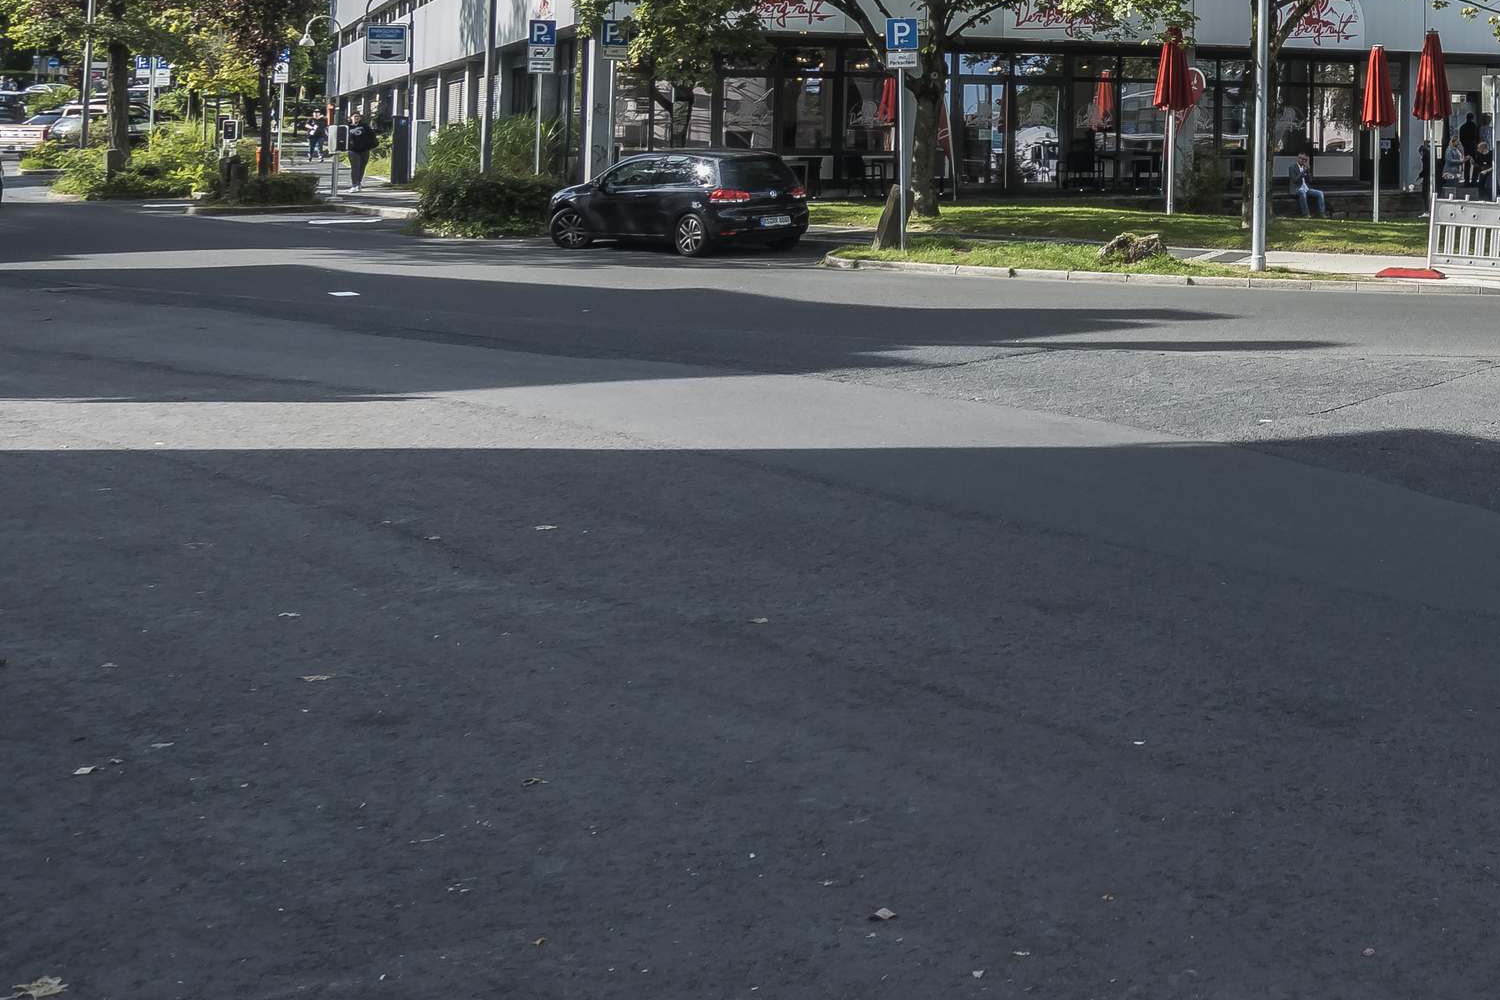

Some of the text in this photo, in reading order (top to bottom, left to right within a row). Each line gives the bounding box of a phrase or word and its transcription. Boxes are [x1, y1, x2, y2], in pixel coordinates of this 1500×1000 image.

[533, 23, 548, 42] P
[894, 22, 911, 46] P
[1042, 6, 1077, 38] Berg
[1294, 12, 1357, 46] Berg ruft
